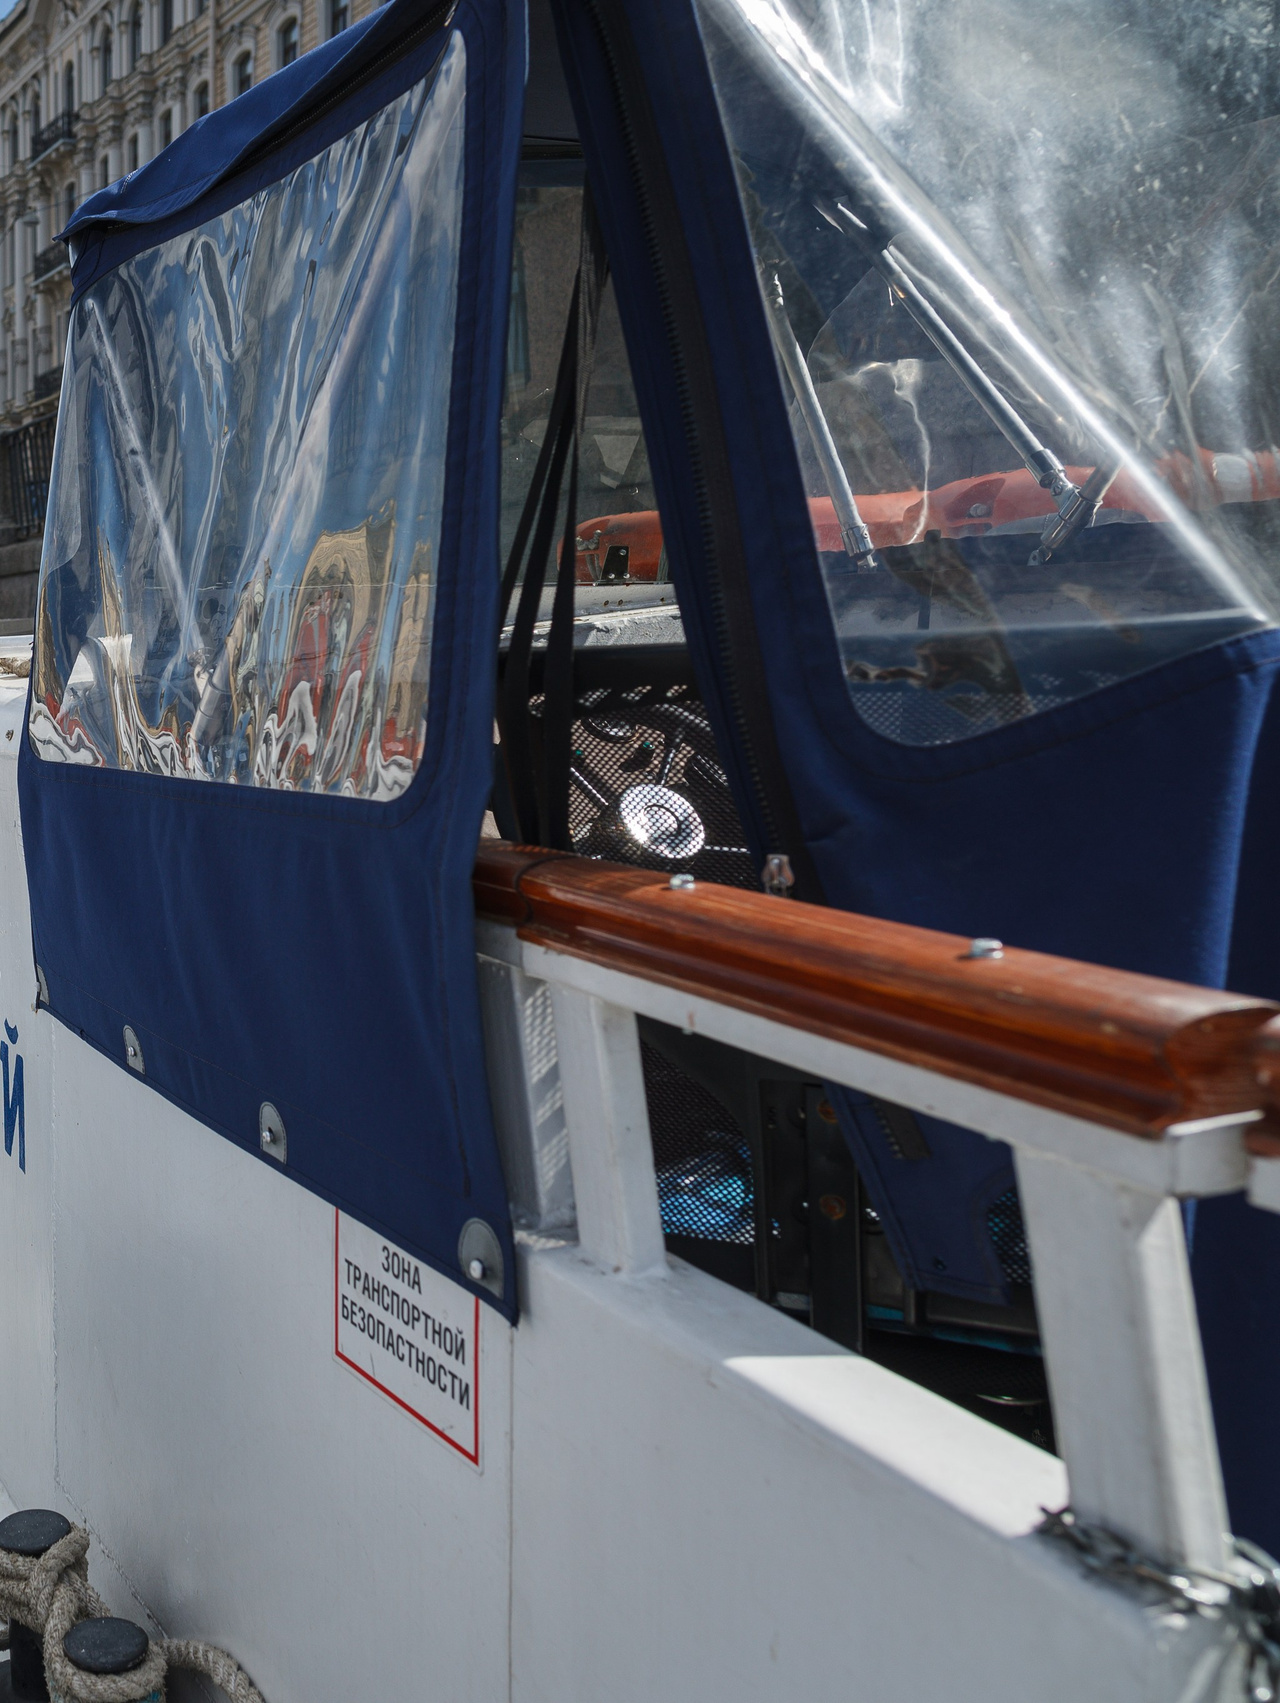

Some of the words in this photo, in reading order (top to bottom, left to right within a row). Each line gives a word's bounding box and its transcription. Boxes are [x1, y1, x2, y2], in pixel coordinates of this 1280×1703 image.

[344, 1258, 466, 1366] ТРАНСПОРТНОЙ
[381, 1245, 422, 1295] ЗОНА
[341, 1293, 471, 1412] БЕЗОПАСТНОСТИ
